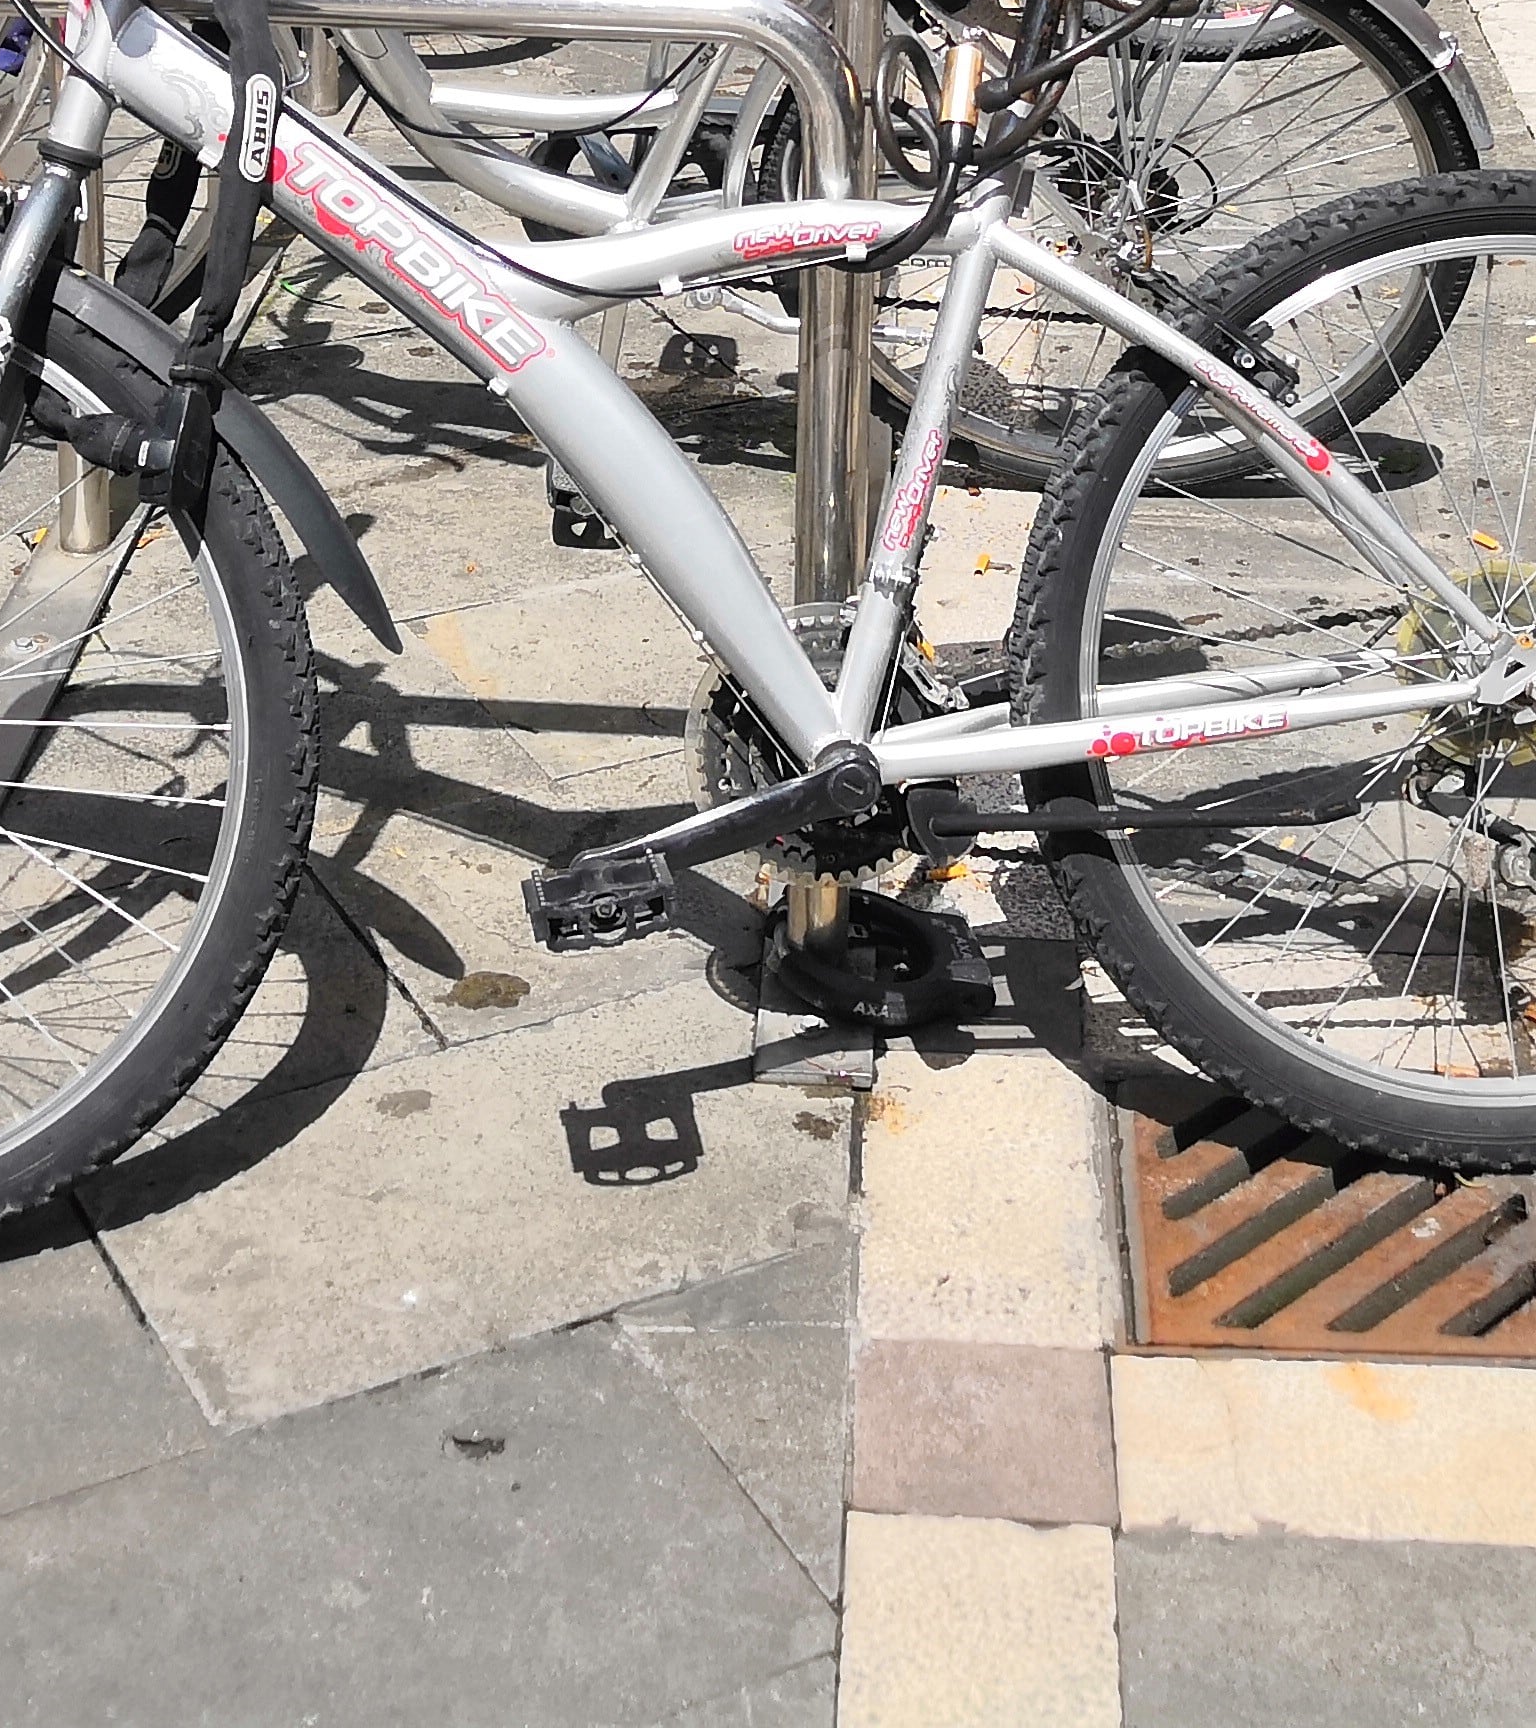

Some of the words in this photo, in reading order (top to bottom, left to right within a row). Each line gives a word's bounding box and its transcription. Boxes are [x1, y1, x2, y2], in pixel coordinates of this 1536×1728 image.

[250, 90, 269, 167] ABUS
[287, 145, 541, 369] TOPBIKE
[1139, 704, 1289, 747] TOPBIKE
